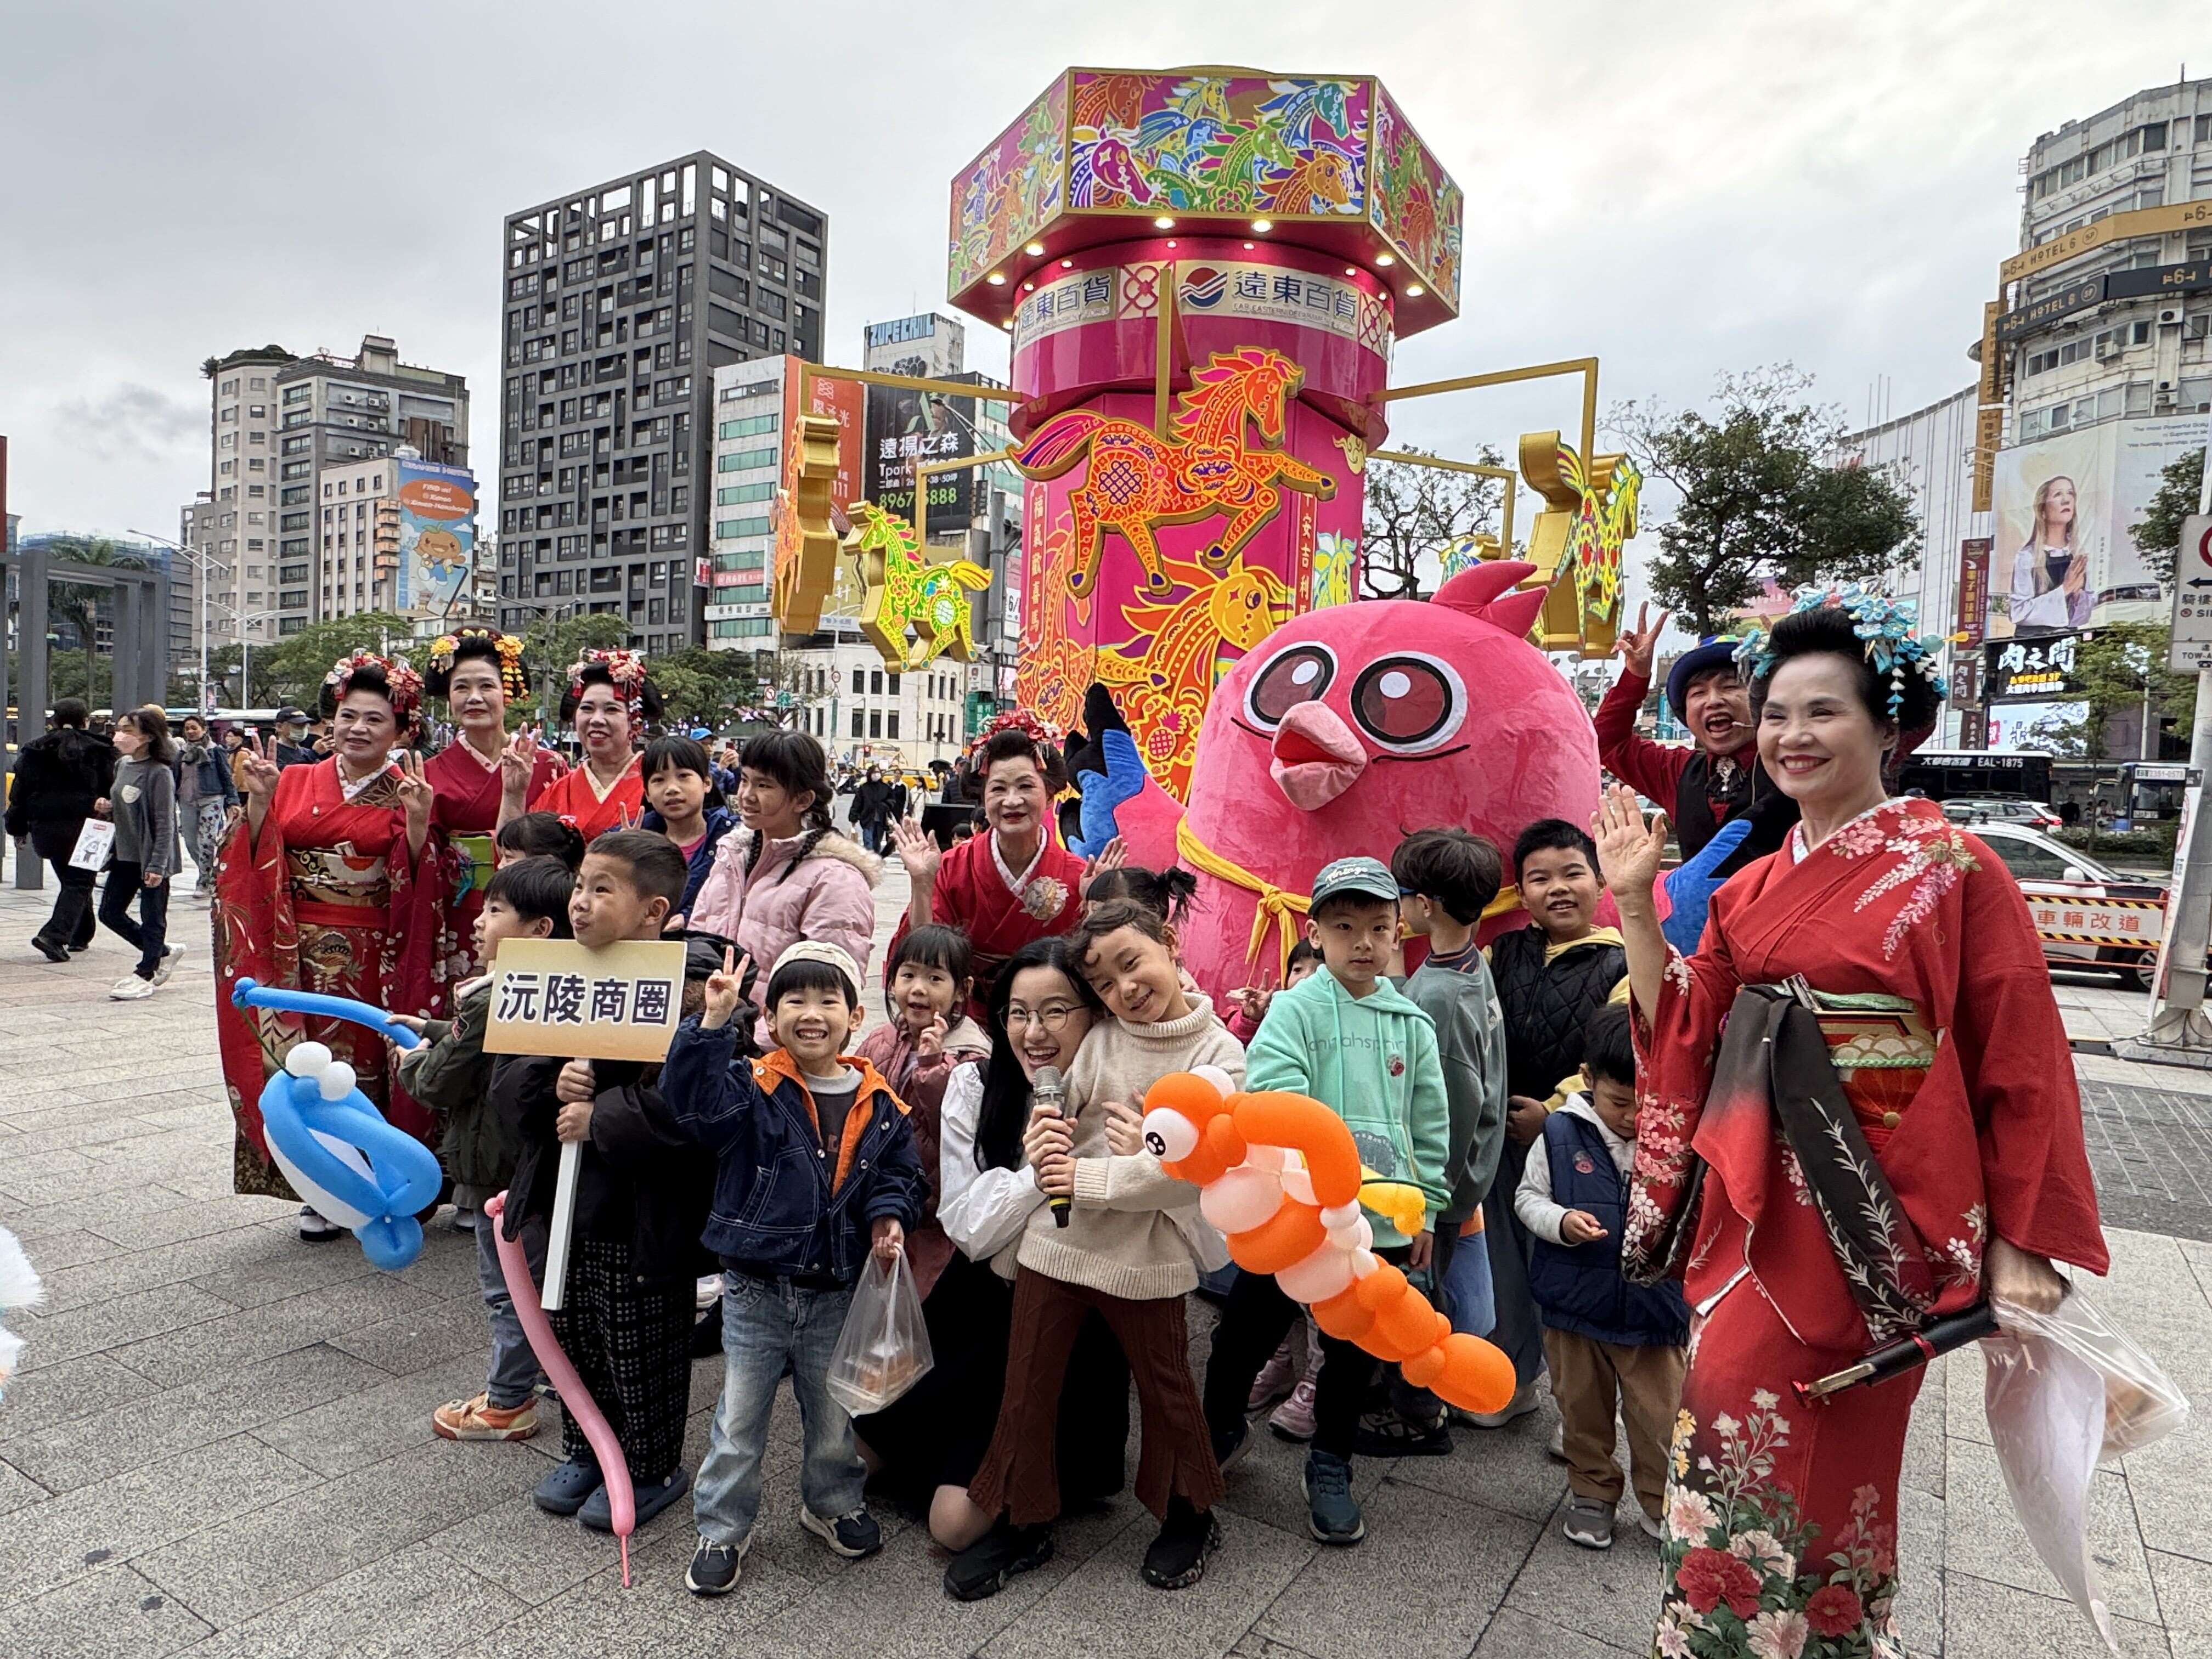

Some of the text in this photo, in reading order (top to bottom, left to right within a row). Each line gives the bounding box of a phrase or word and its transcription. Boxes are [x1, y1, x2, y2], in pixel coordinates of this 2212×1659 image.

[2031, 242, 2066, 265] HOTEL
[2069, 237, 2076, 249] 6
[1021, 273, 1111, 332] 遠東百貨
[1234, 270, 1357, 322] 遠東百貨
[2030, 298, 2065, 321] HOTEL
[2068, 293, 2076, 306] 6
[879, 431, 959, 460] 遠揚之森
[879, 460, 913, 482] Tpark
[1977, 757, 2023, 768] EAL-1875
[2036, 910, 2141, 933] 車輛改道
[497, 972, 673, 1025] 沅陵商圈
